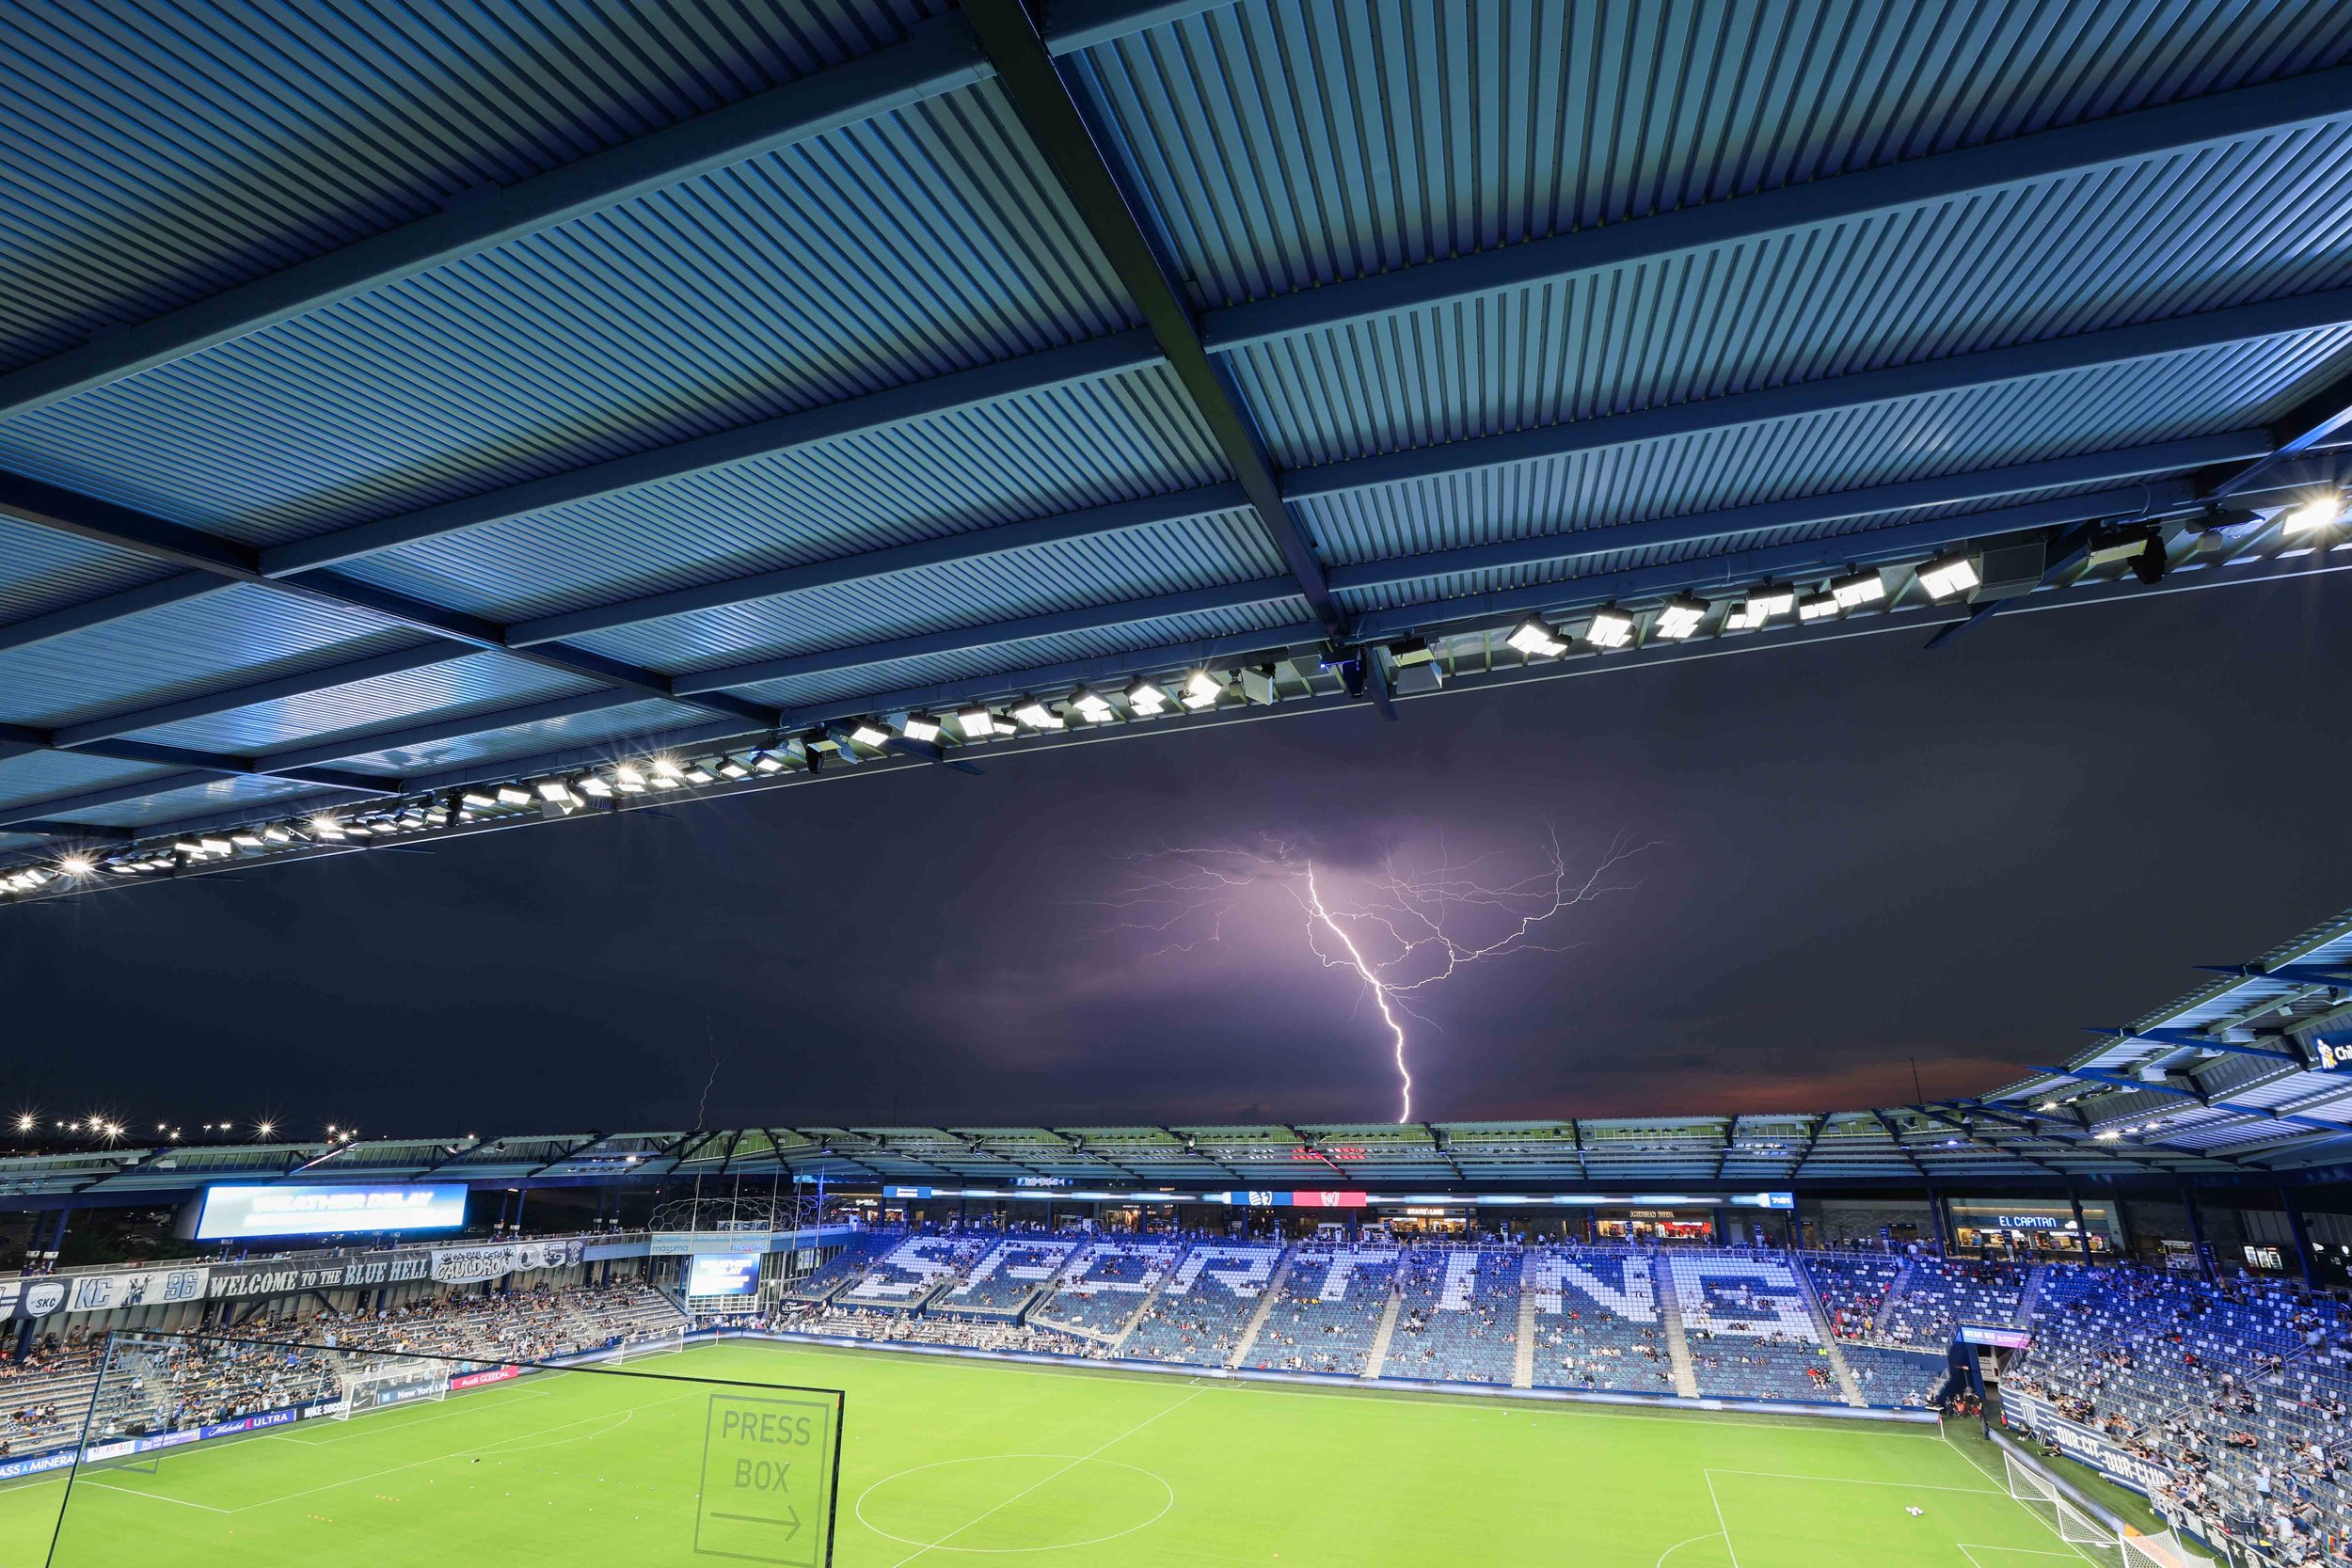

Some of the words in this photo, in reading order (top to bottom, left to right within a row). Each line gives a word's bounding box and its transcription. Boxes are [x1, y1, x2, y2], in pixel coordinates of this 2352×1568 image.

[1999, 1216, 2012, 1227] EL
[2013, 1216, 2058, 1227] CAPITAN
[652, 1243, 689, 1254] mazuma
[731, 1243, 769, 1254] mazuma
[435, 1256, 516, 1280] CAULDRON
[209, 1271, 298, 1298] WELCOME
[301, 1272, 317, 1287] TO
[320, 1270, 342, 1285] THE
[342, 1261, 388, 1286] BLUE
[388, 1259, 428, 1282] HELL
[74, 1278, 113, 1308] KC
[164, 1271, 199, 1300] 96
[847, 1235, 1821, 1345] SPORTING
[36, 1298, 56, 1308] SKC
[462, 1376, 479, 1386] Audi
[397, 1389, 416, 1400] New
[416, 1385, 434, 1396] York
[435, 1383, 450, 1392] Lie
[304, 1405, 323, 1418] NIKE
[253, 1414, 288, 1427] ULTRA
[722, 1410, 811, 1447] PRESS
[2056, 1425, 2079, 1449] OUR
[2104, 1449, 2134, 1480] OUR
[734, 1458, 790, 1494] BOX
